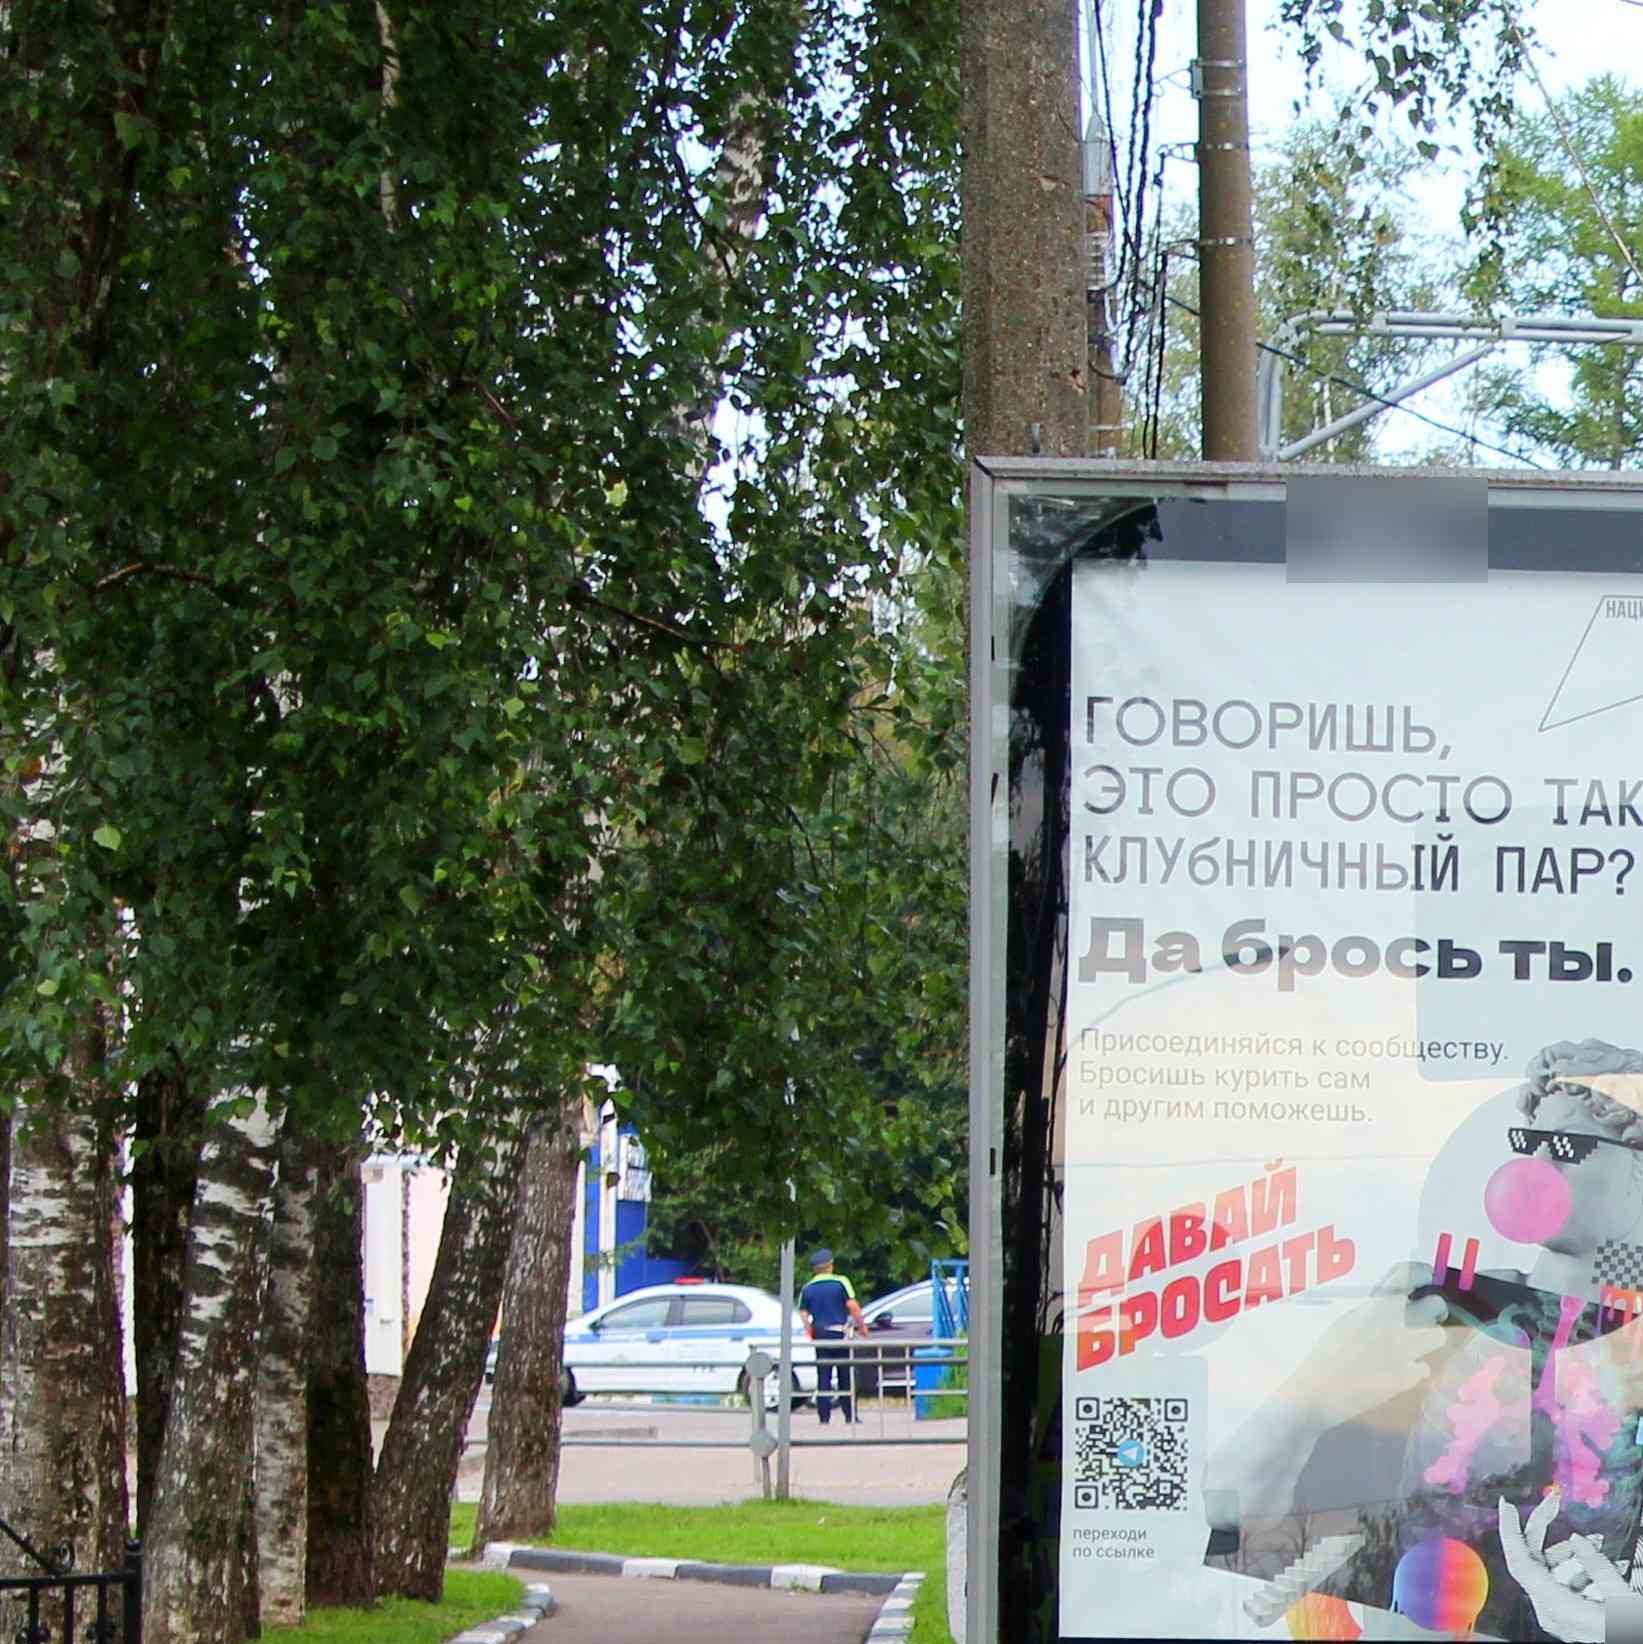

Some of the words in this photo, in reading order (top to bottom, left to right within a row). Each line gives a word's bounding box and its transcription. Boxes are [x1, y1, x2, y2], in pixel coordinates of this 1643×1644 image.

[1085, 694, 1453, 760] ГОВОРИШЬ,
[1083, 763, 1217, 818] ЭТО
[1251, 770, 1513, 825] ПРОСТО
[1495, 845, 1636, 896] ПАР?
[1078, 915, 1203, 984] Да
[1221, 917, 1483, 993] брось
[1498, 939, 1633, 984] ты.
[1080, 1027, 1303, 1057] Присоединяйся
[1312, 1039, 1328, 1057] к
[1335, 1033, 1509, 1066] сообществу.
[1079, 1059, 1206, 1089] Бросишь
[1215, 1069, 1309, 1094] курить
[1317, 1070, 1371, 1090] сам
[1079, 1098, 1096, 1115] и
[1103, 1099, 1204, 1123] другим
[1213, 1101, 1374, 1123] поможешь.
[1077, 1158, 1298, 1310] ДАВАЙ
[1076, 1224, 1357, 1373] БРОСАТЬ
[1073, 1528, 1146, 1542] переходи
[1073, 1546, 1092, 1558] по
[1096, 1547, 1154, 1558] ссылке
